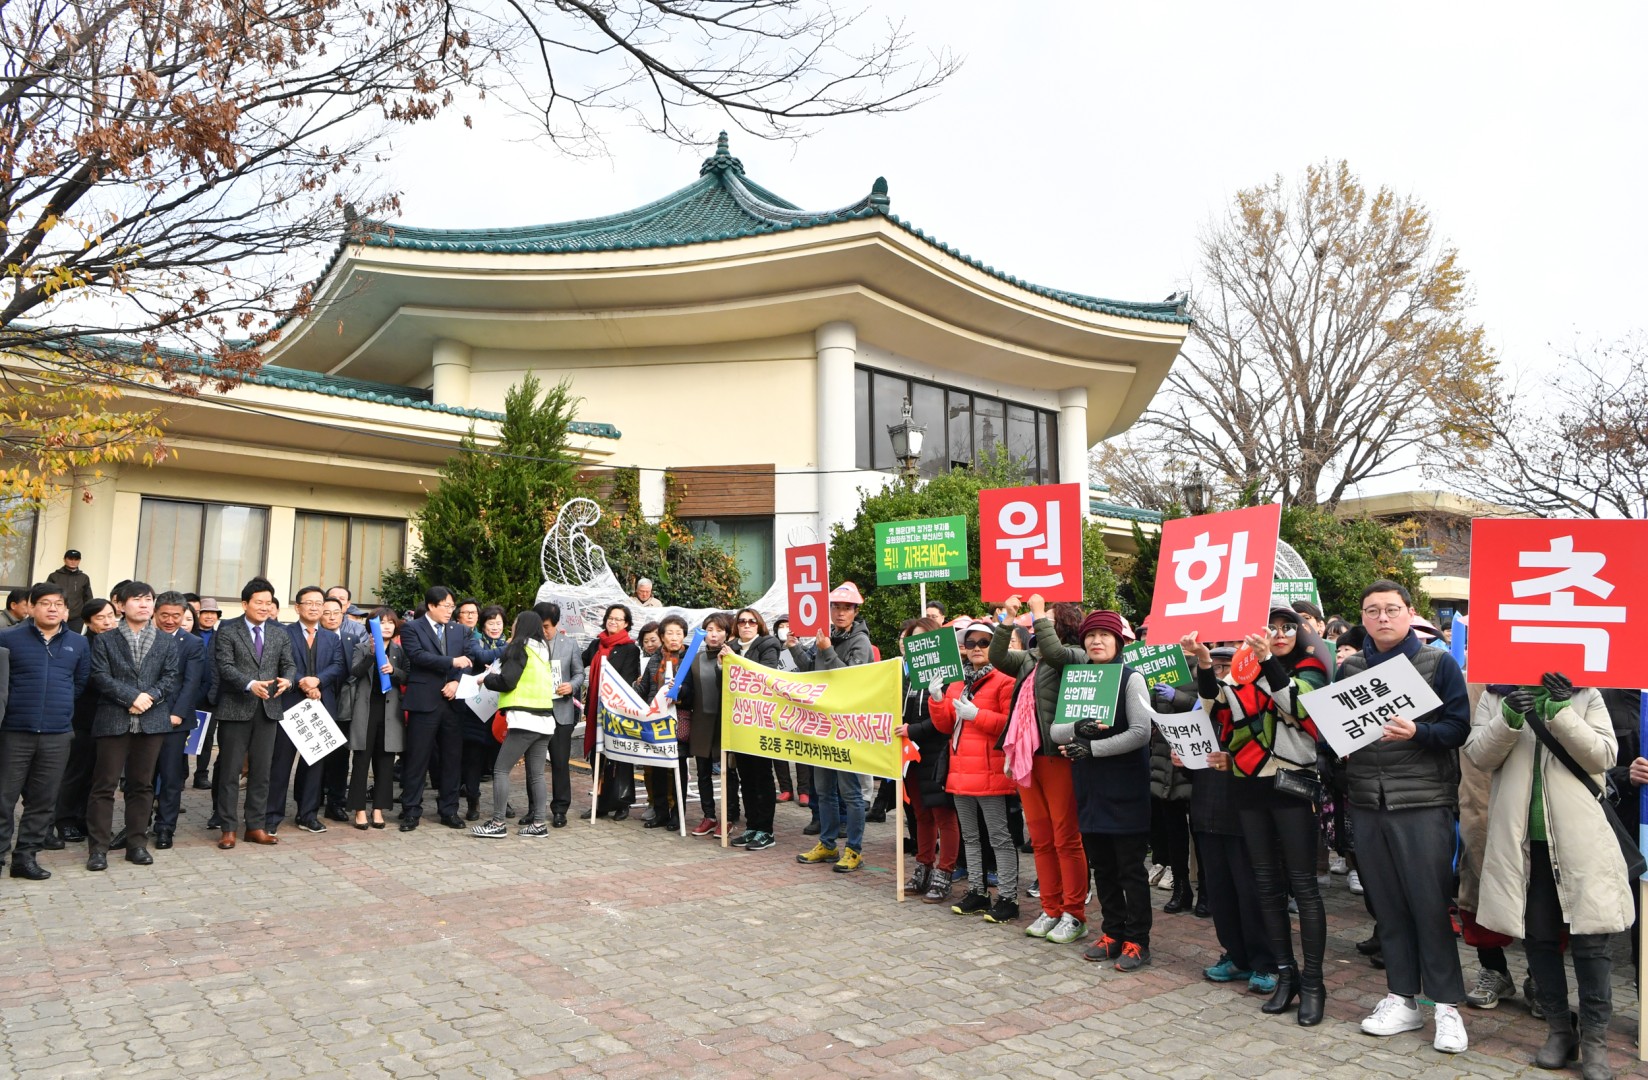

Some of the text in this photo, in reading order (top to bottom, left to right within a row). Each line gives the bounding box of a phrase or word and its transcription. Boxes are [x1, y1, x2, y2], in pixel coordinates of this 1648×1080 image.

[886, 530, 955, 544] 공원화하겠다는 부산시의 약속
[889, 522, 950, 536] 옛 해운대역 정거장 부지를
[996, 500, 1064, 588] 원
[884, 544, 959, 570] 꼭!! 지켜주세요~~
[897, 569, 951, 580] 송정동 주민자치위원회
[1164, 531, 1258, 623] 화
[793, 555, 822, 627] 공
[1498, 535, 1627, 672] 촉
[908, 635, 940, 653] 뭐라카노?
[912, 651, 940, 669] 상업개발
[729, 665, 773, 697] 명품공원
[918, 668, 931, 683] 절대
[1066, 670, 1104, 683] 뭐라카노?
[1158, 670, 1180, 684] 추진!
[1064, 687, 1097, 701] 상업개발
[1331, 678, 1392, 711] 개발을
[732, 698, 893, 744] 상업개발, 난개발을 방지하라!
[1065, 704, 1110, 720] 절대 안된다!
[1342, 694, 1416, 740] 금지한다
[290, 713, 315, 743] 우리들의
[612, 739, 640, 753] 반여3동
[759, 735, 852, 765] 중2동 주민자치위원회
[1189, 740, 1213, 757] 찬성
